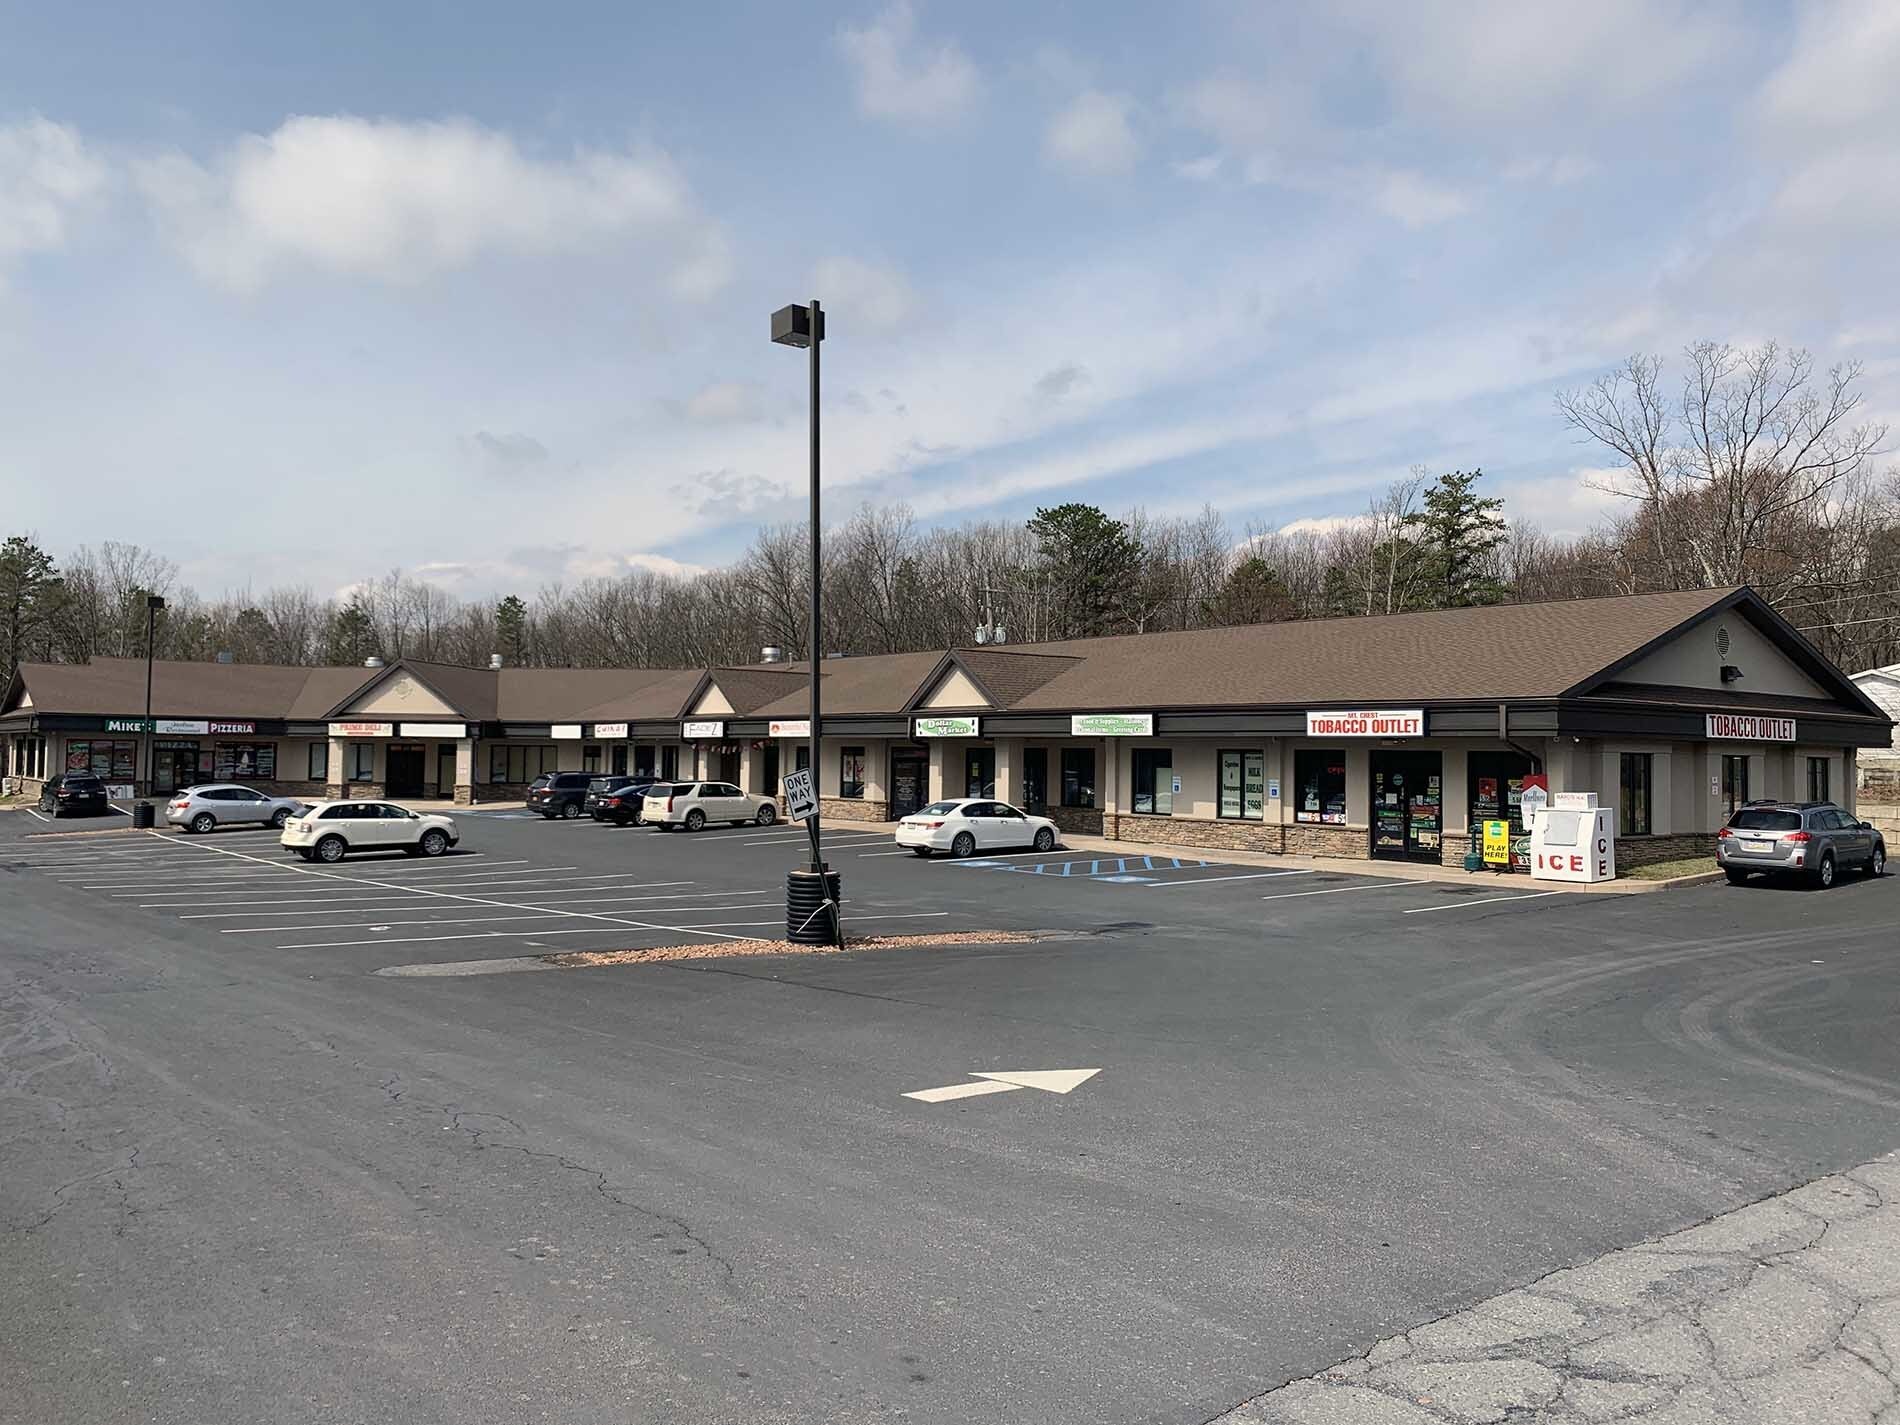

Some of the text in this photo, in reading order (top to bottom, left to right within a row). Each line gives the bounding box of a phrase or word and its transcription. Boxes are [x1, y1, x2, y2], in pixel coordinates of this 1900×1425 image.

[210, 723, 253, 733] PIZZERIA
[938, 727, 968, 735] Market
[1310, 719, 1419, 733] TOBACCO OUTLET
[1709, 715, 1793, 739] TOBACCO OUTLET
[788, 774, 808, 789] ONE
[790, 786, 810, 802] WAY
[1539, 854, 1583, 872] ICE
